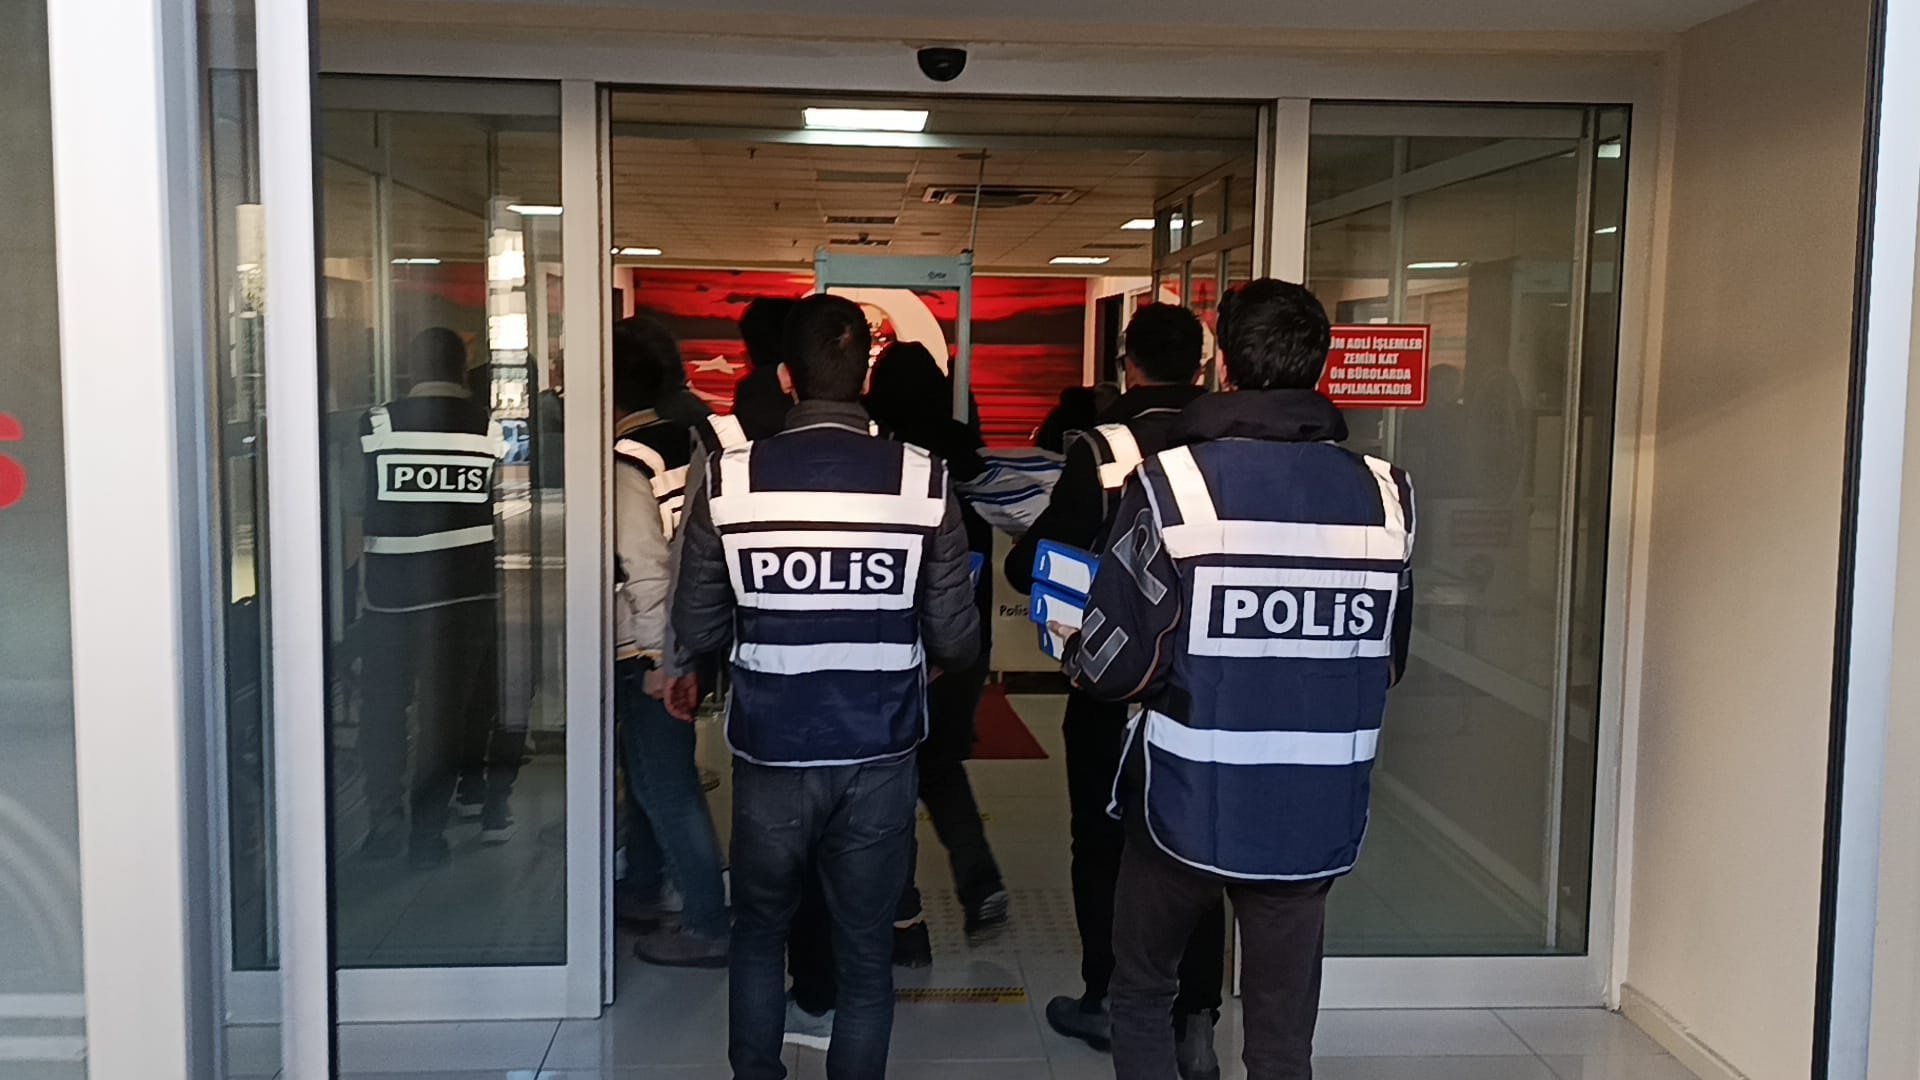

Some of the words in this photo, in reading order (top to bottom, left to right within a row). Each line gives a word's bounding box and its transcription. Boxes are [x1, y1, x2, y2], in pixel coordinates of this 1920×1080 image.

[1346, 336, 1371, 350] ADLİ
[1373, 336, 1423, 351] İŞLEMLER
[1343, 351, 1377, 365] ZEMİN
[1378, 352, 1399, 365] KAT
[1330, 366, 1345, 380] ÖN
[1328, 382, 1412, 395] YAPILMAKTADIR
